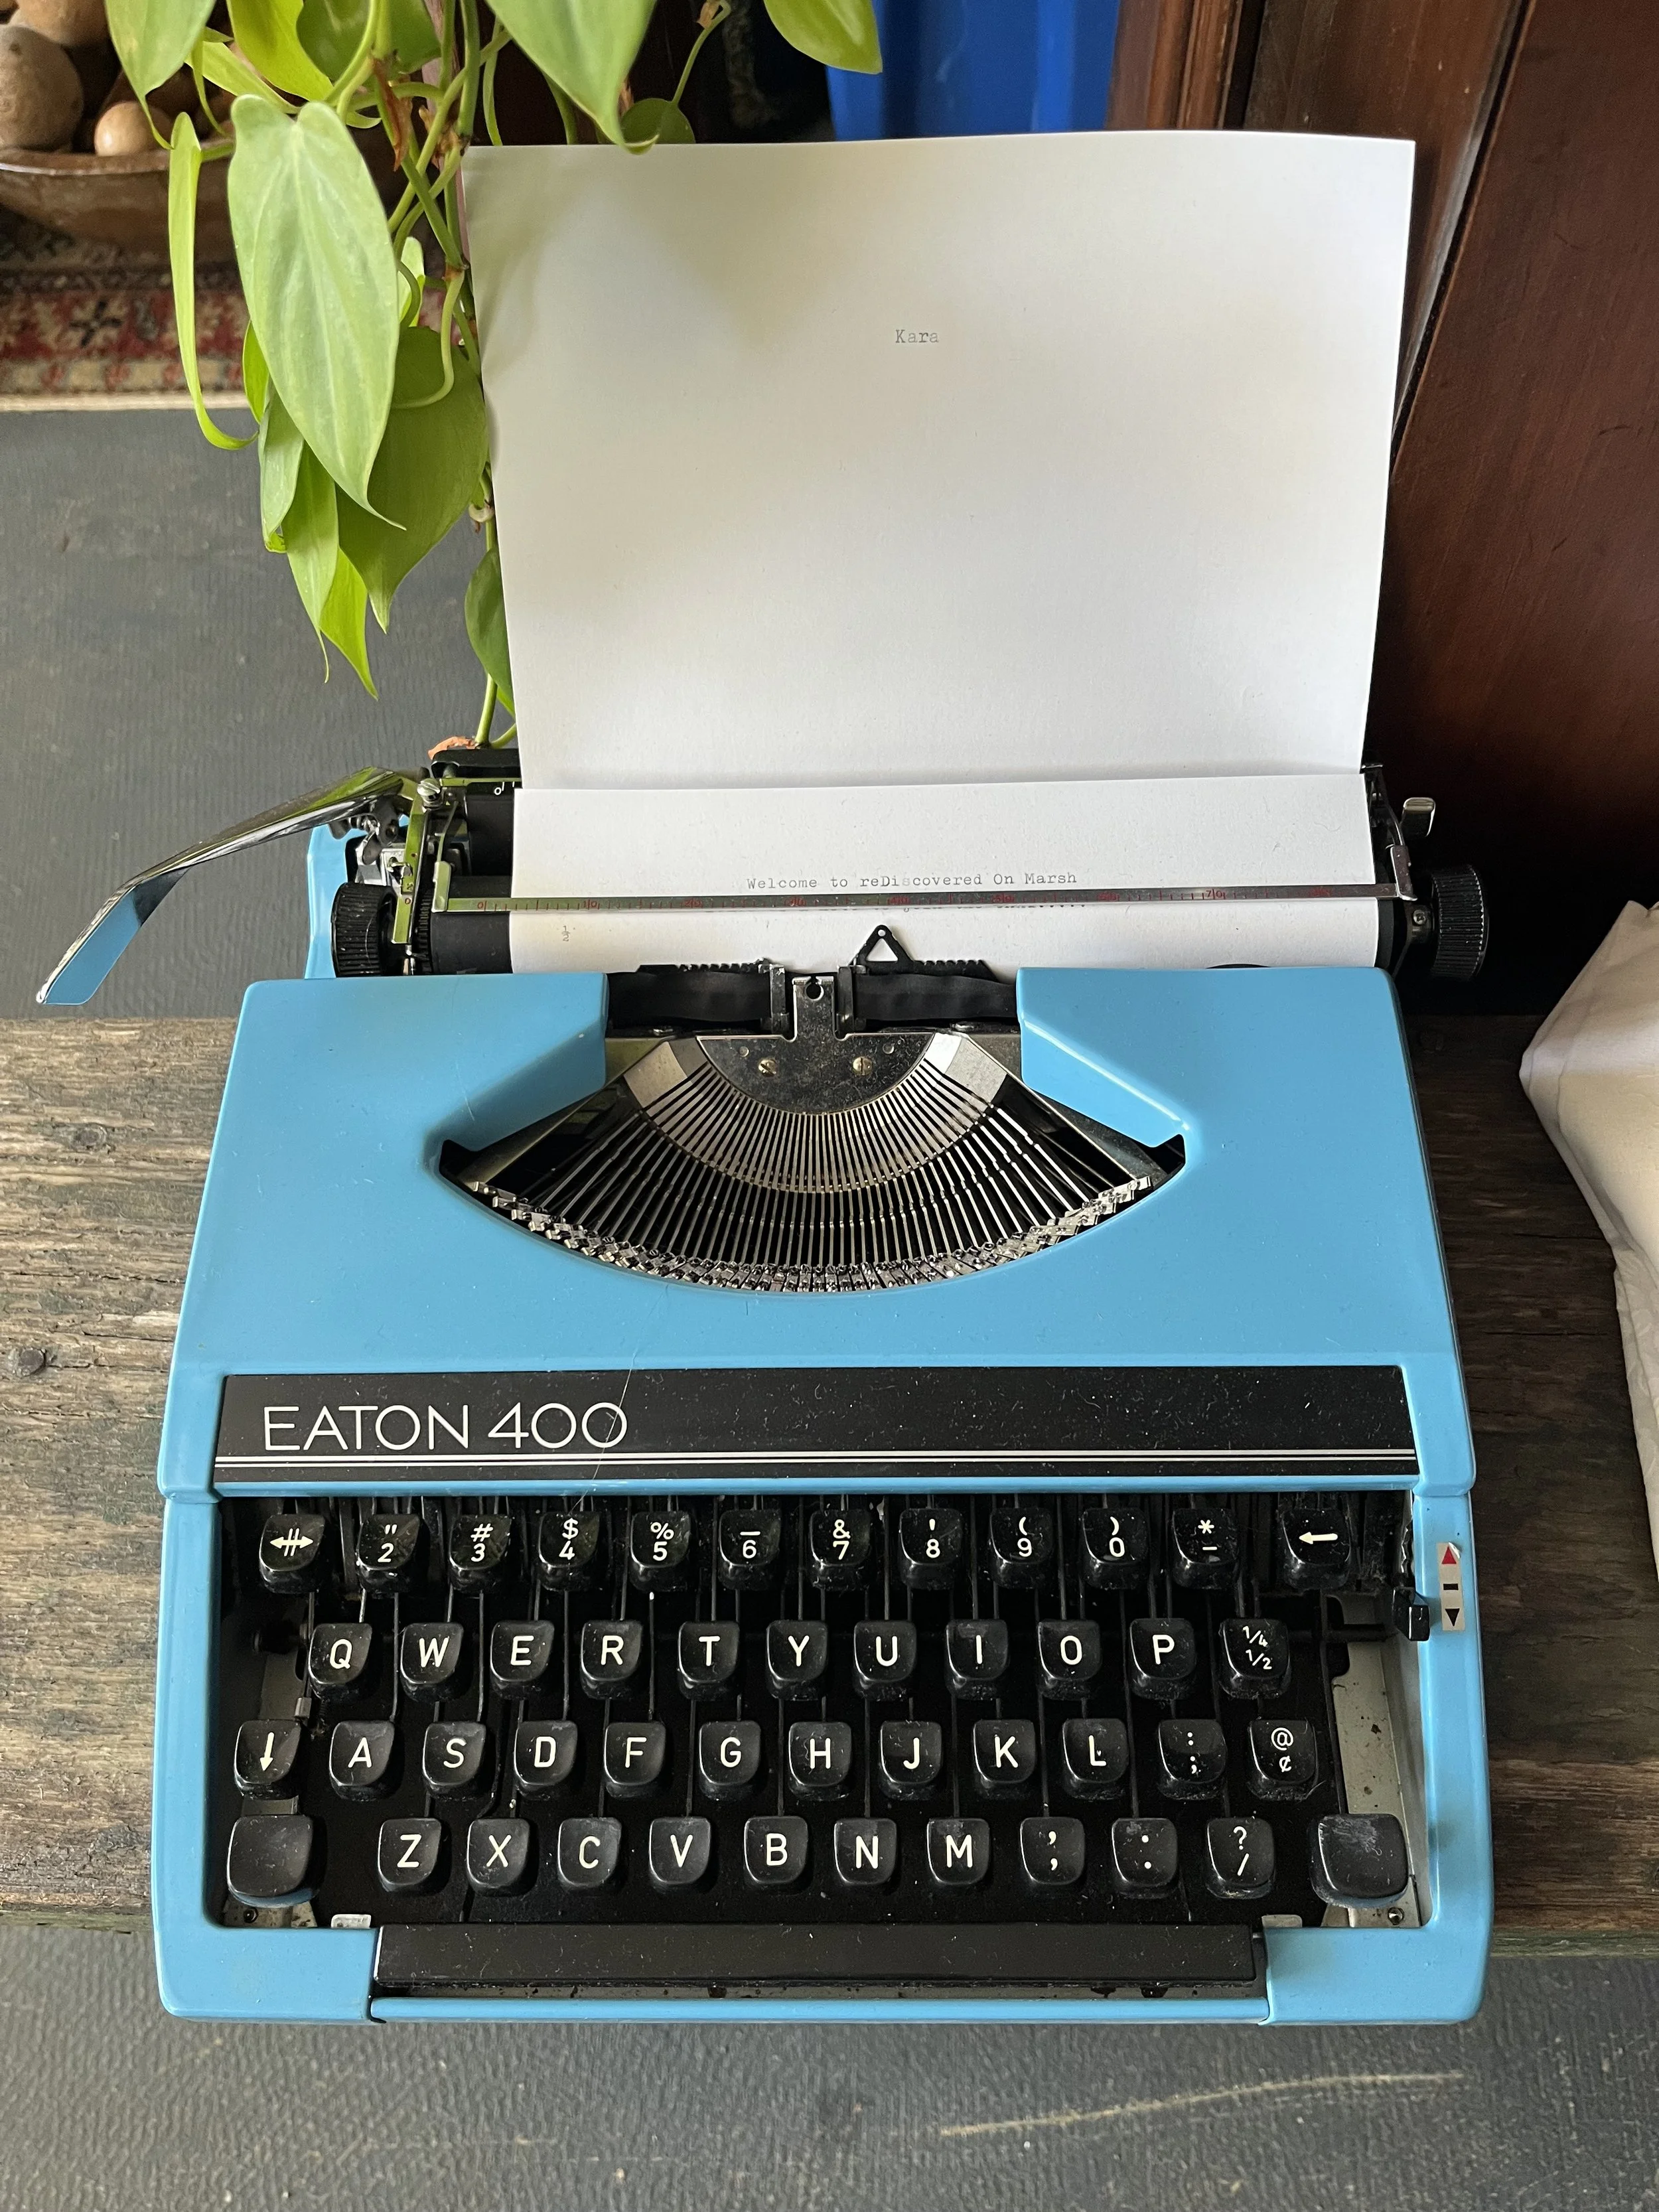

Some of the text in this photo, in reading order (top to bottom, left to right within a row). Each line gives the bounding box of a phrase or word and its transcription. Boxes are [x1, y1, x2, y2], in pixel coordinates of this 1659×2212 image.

[895, 329, 939, 344] Kara
[746, 871, 1077, 889] Welcome to reDiscovered On Marsh
[264, 1402, 628, 1451] EATON 400
[470, 1523, 494, 1542] #
[561, 1517, 579, 1540] $
[650, 1522, 674, 1540] %
[833, 1519, 851, 1539] &
[377, 1542, 394, 1563] 2
[470, 1542, 486, 1562] 3
[559, 1540, 575, 1560] 4
[652, 1541, 668, 1561] 5
[743, 1539, 757, 1559] 6
[833, 1540, 849, 1560] 7
[926, 1538, 940, 1558] 8
[1017, 1538, 1033, 1557] 9
[329, 1639, 352, 1669] Q
[419, 1636, 450, 1668] W
[510, 1635, 534, 1666] E
[601, 1635, 624, 1665] R
[698, 1635, 721, 1666] T
[788, 1635, 810, 1667] Y
[875, 1635, 898, 1666] U
[975, 1635, 983, 1664] I
[1060, 1635, 1082, 1665] O
[1152, 1634, 1175, 1665] P
[348, 1737, 372, 1768] A
[443, 1737, 467, 1768] S
[534, 1736, 556, 1768] D
[624, 1737, 647, 1768] F
[720, 1737, 741, 1768] G
[810, 1737, 831, 1769] H
[903, 1737, 920, 1769] J
[995, 1735, 1019, 1768] K
[1088, 1735, 1107, 1767] L
[1271, 1727, 1294, 1751] @
[397, 1834, 422, 1868] Z
[486, 1834, 512, 1868] X
[579, 1836, 601, 1869] C
[670, 1834, 693, 1868] V
[766, 1833, 788, 1866] B
[855, 1835, 879, 1869] N
[946, 1834, 973, 1868] M
[1233, 1826, 1247, 1850] ?
